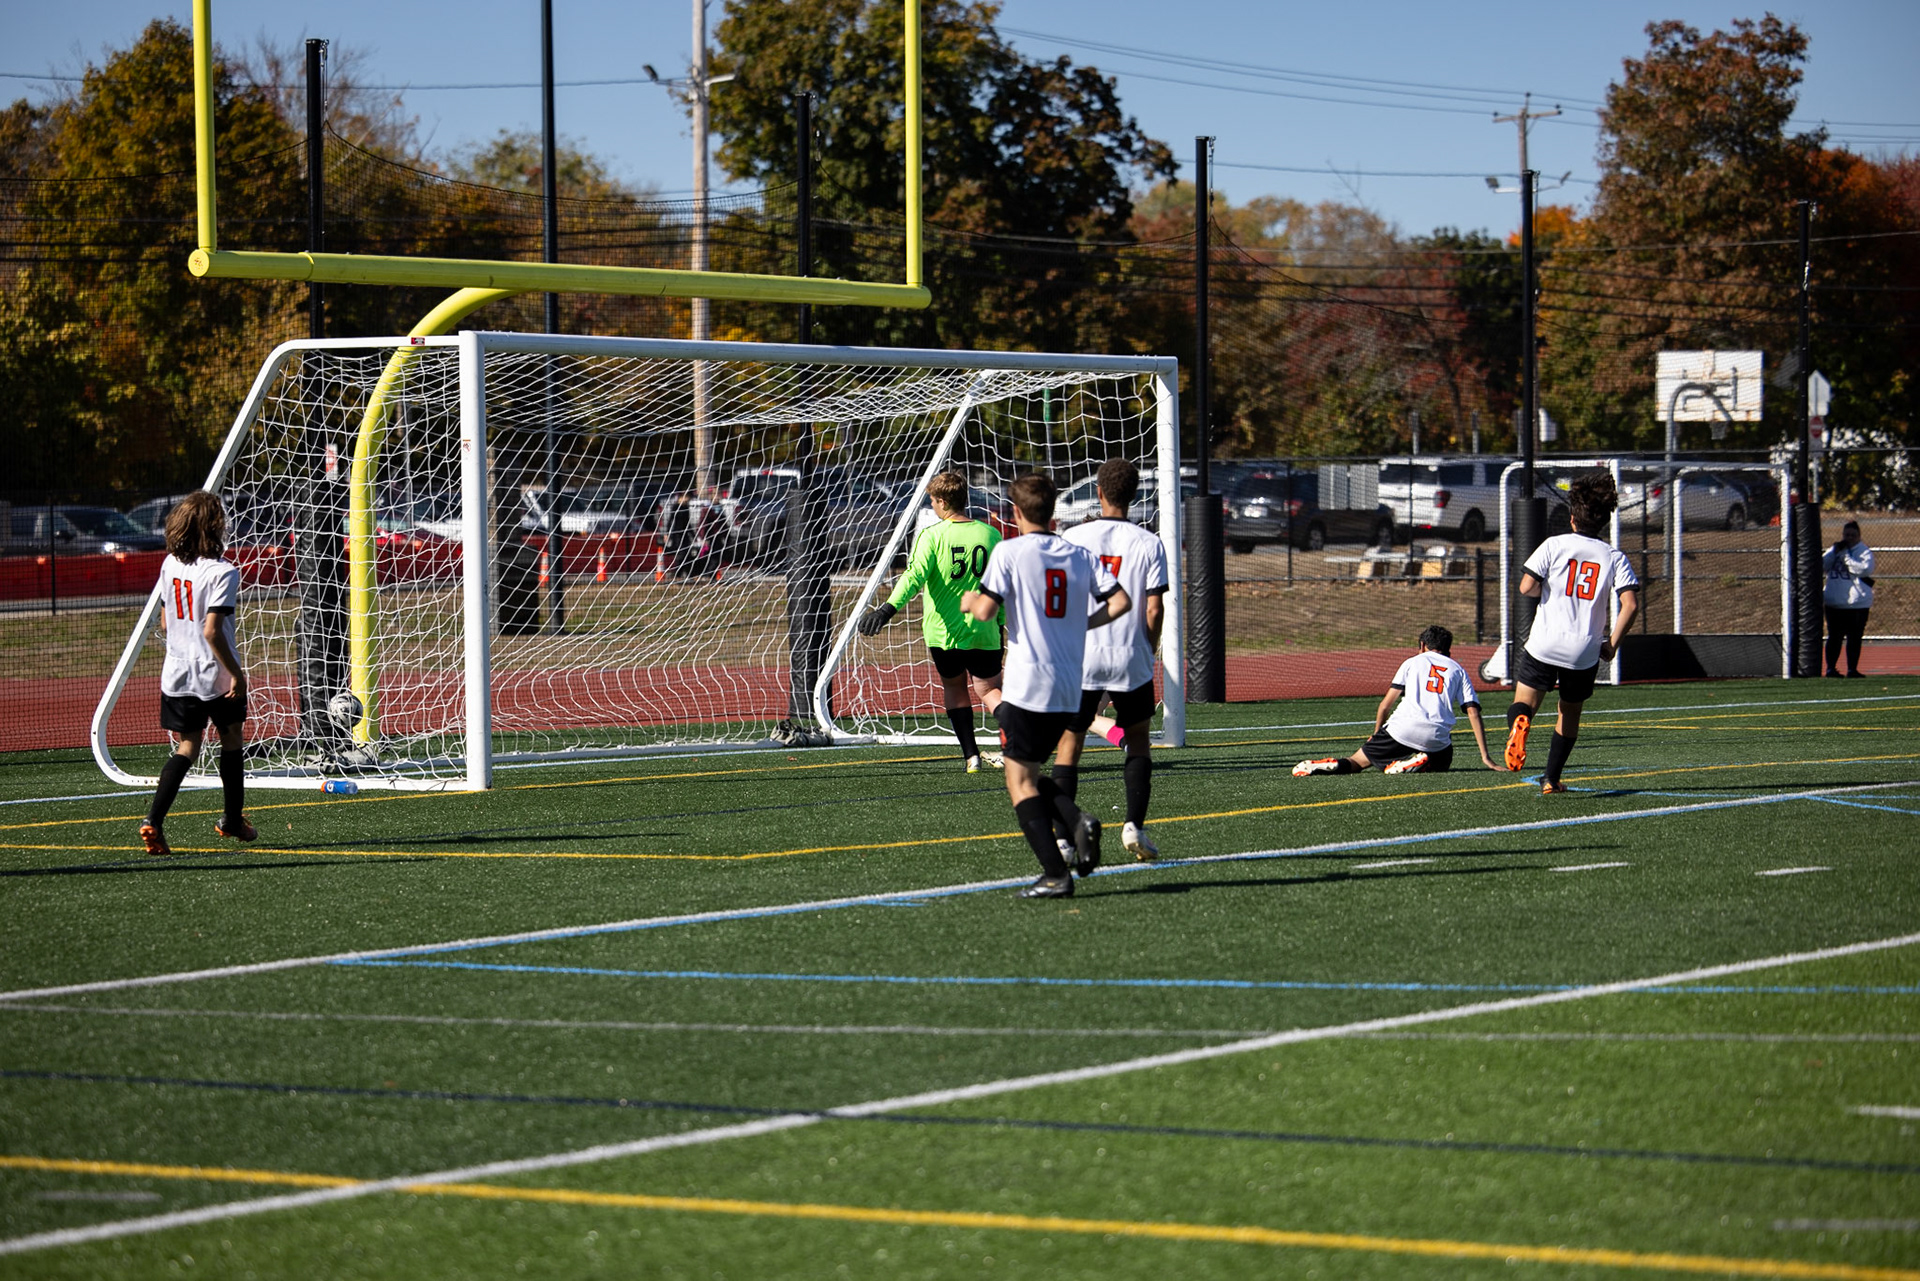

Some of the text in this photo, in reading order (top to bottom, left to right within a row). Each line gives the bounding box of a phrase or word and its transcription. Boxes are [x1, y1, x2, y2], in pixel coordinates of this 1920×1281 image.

[951, 544, 988, 579] 50
[1565, 558, 1601, 601] 13
[172, 577, 194, 622] 11
[1045, 568, 1068, 619] 8
[1426, 664, 1448, 694] 5
